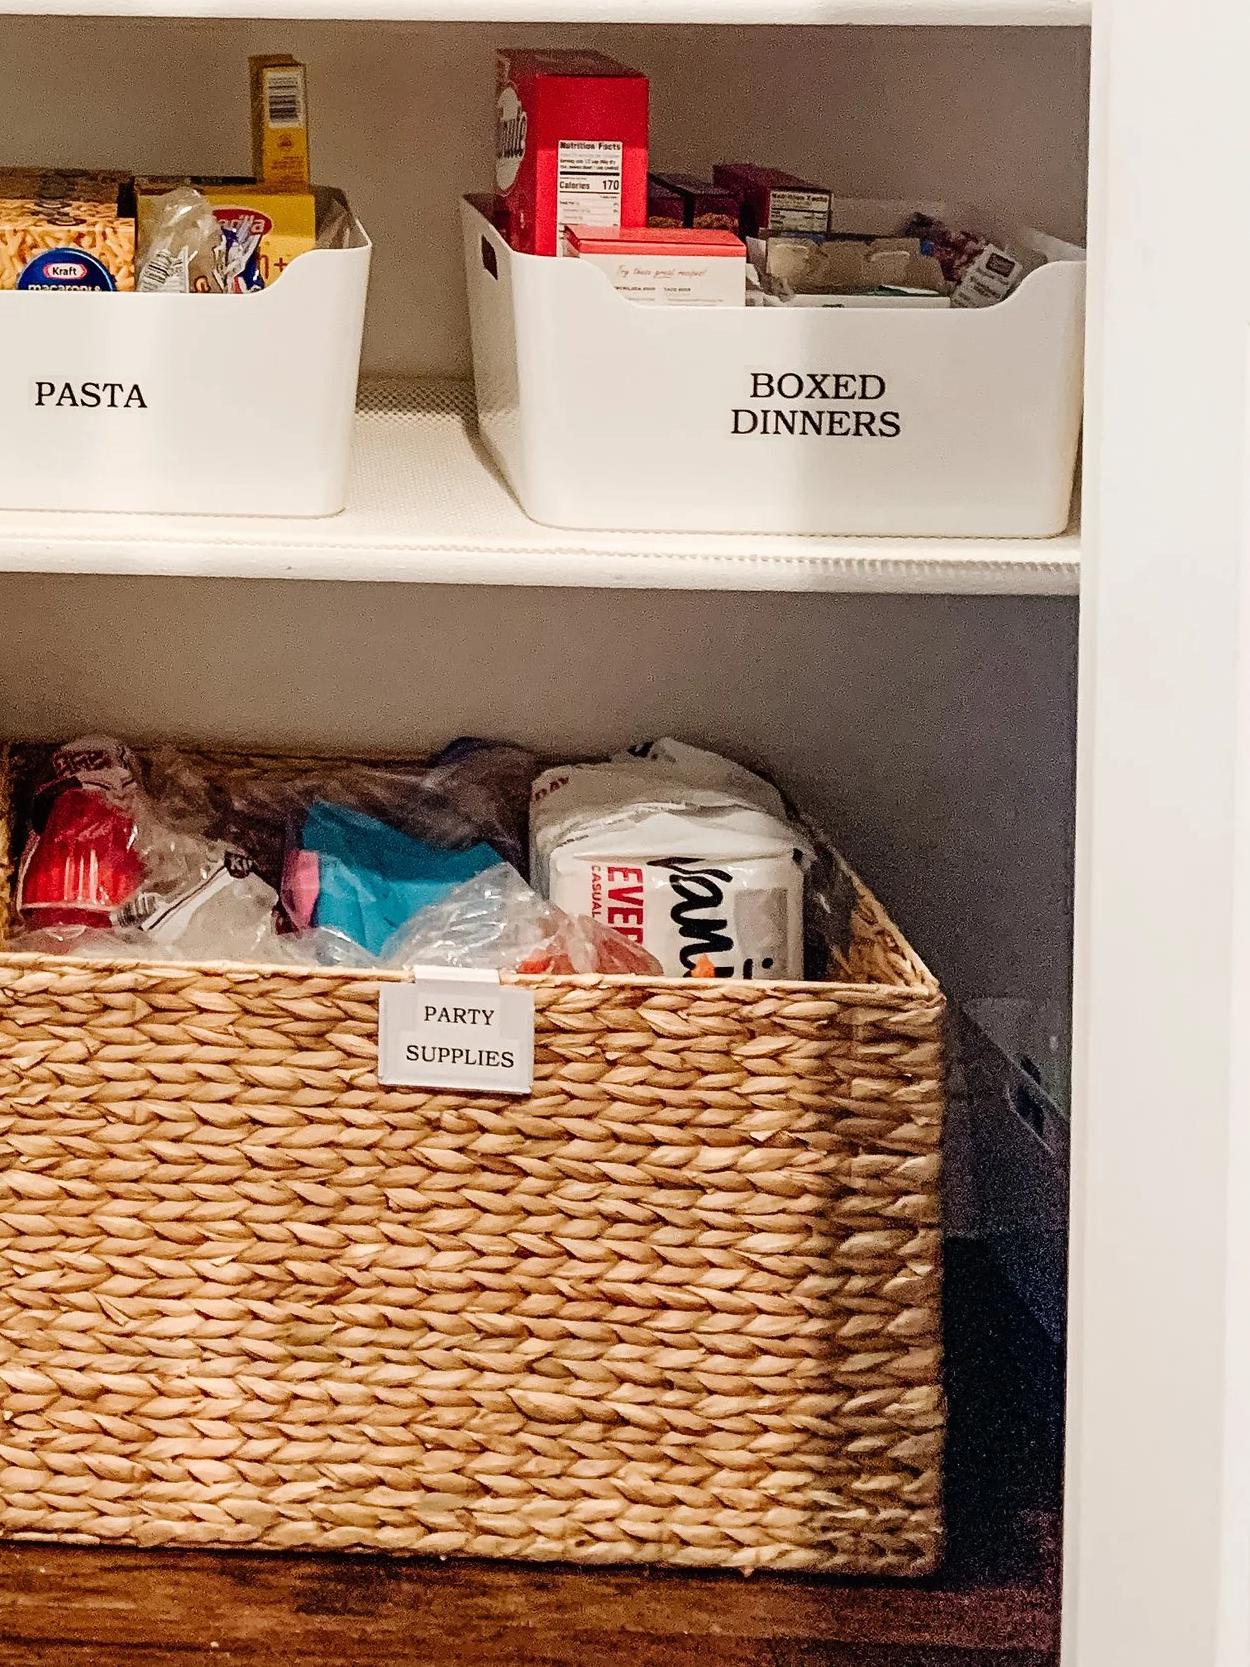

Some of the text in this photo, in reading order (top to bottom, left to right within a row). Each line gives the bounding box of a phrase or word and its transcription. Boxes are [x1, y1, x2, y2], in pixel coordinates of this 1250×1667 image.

[559, 141, 621, 151] Nutrition Facts
[559, 180, 620, 191] Calories 170
[217, 214, 267, 234] arilla
[51, 265, 78, 276] Kraft
[34, 381, 148, 409] PASTA
[750, 373, 887, 401] BOXED
[731, 409, 902, 438] DINNERS
[590, 865, 602, 918] CASUAL
[424, 1005, 495, 1026] PARTY
[405, 1044, 515, 1069] SUPPLIES
